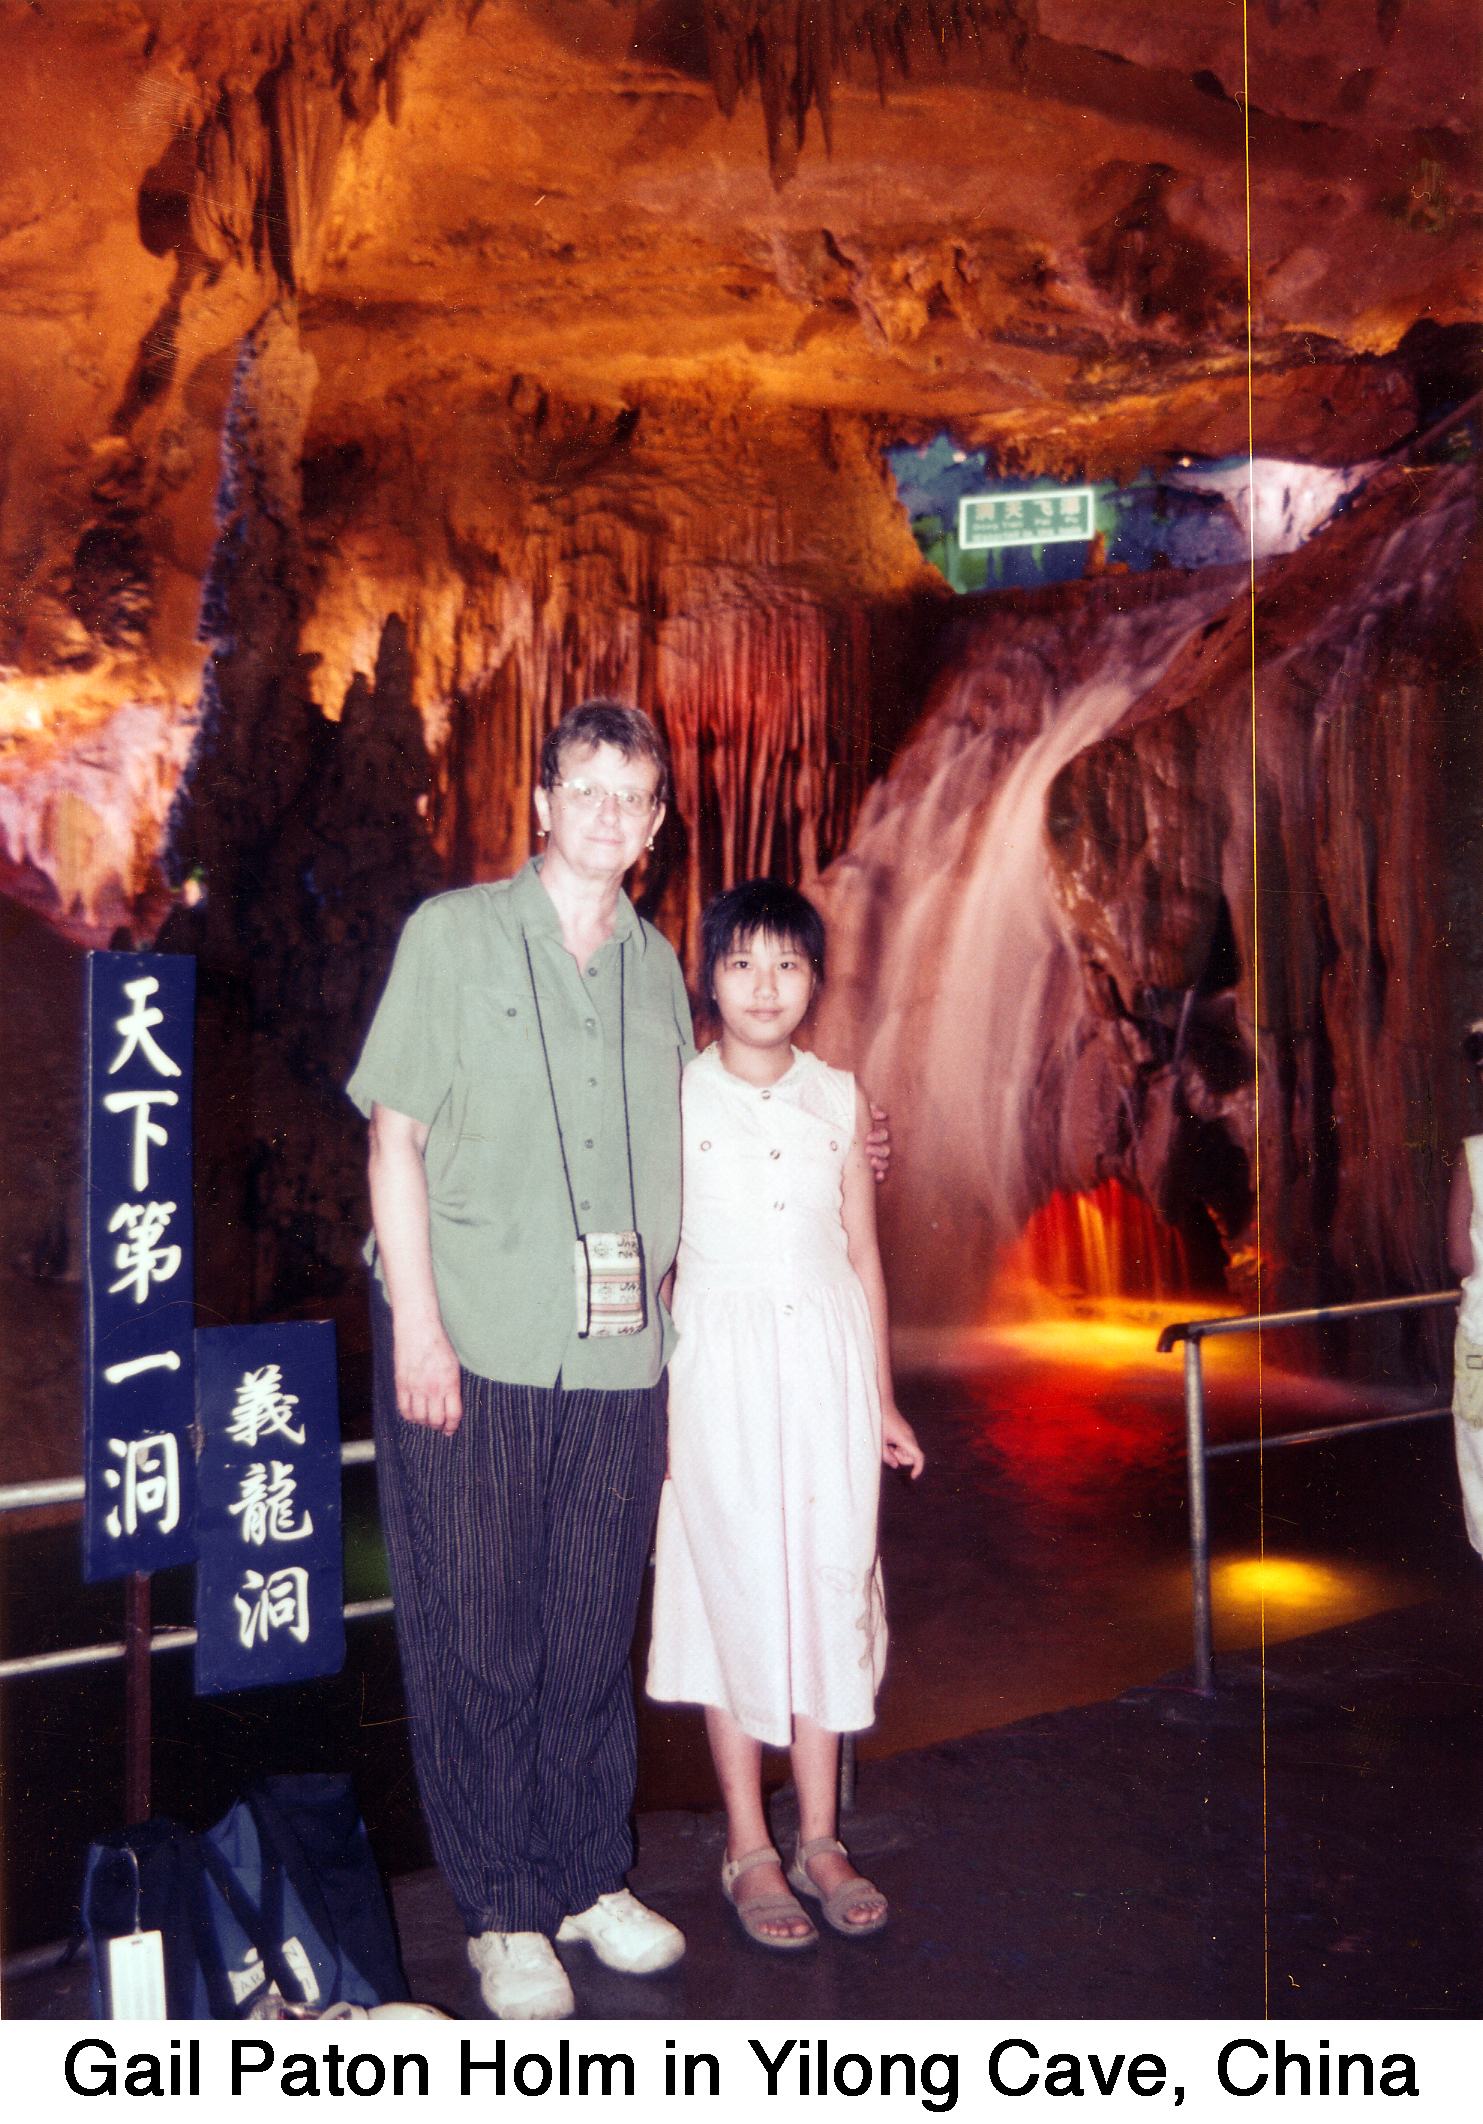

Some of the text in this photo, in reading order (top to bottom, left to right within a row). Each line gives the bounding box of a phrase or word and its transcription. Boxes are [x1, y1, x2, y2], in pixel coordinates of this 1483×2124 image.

[103, 976, 182, 1538] 天下第一洞
[225, 1364, 313, 1649] 義龍洞
